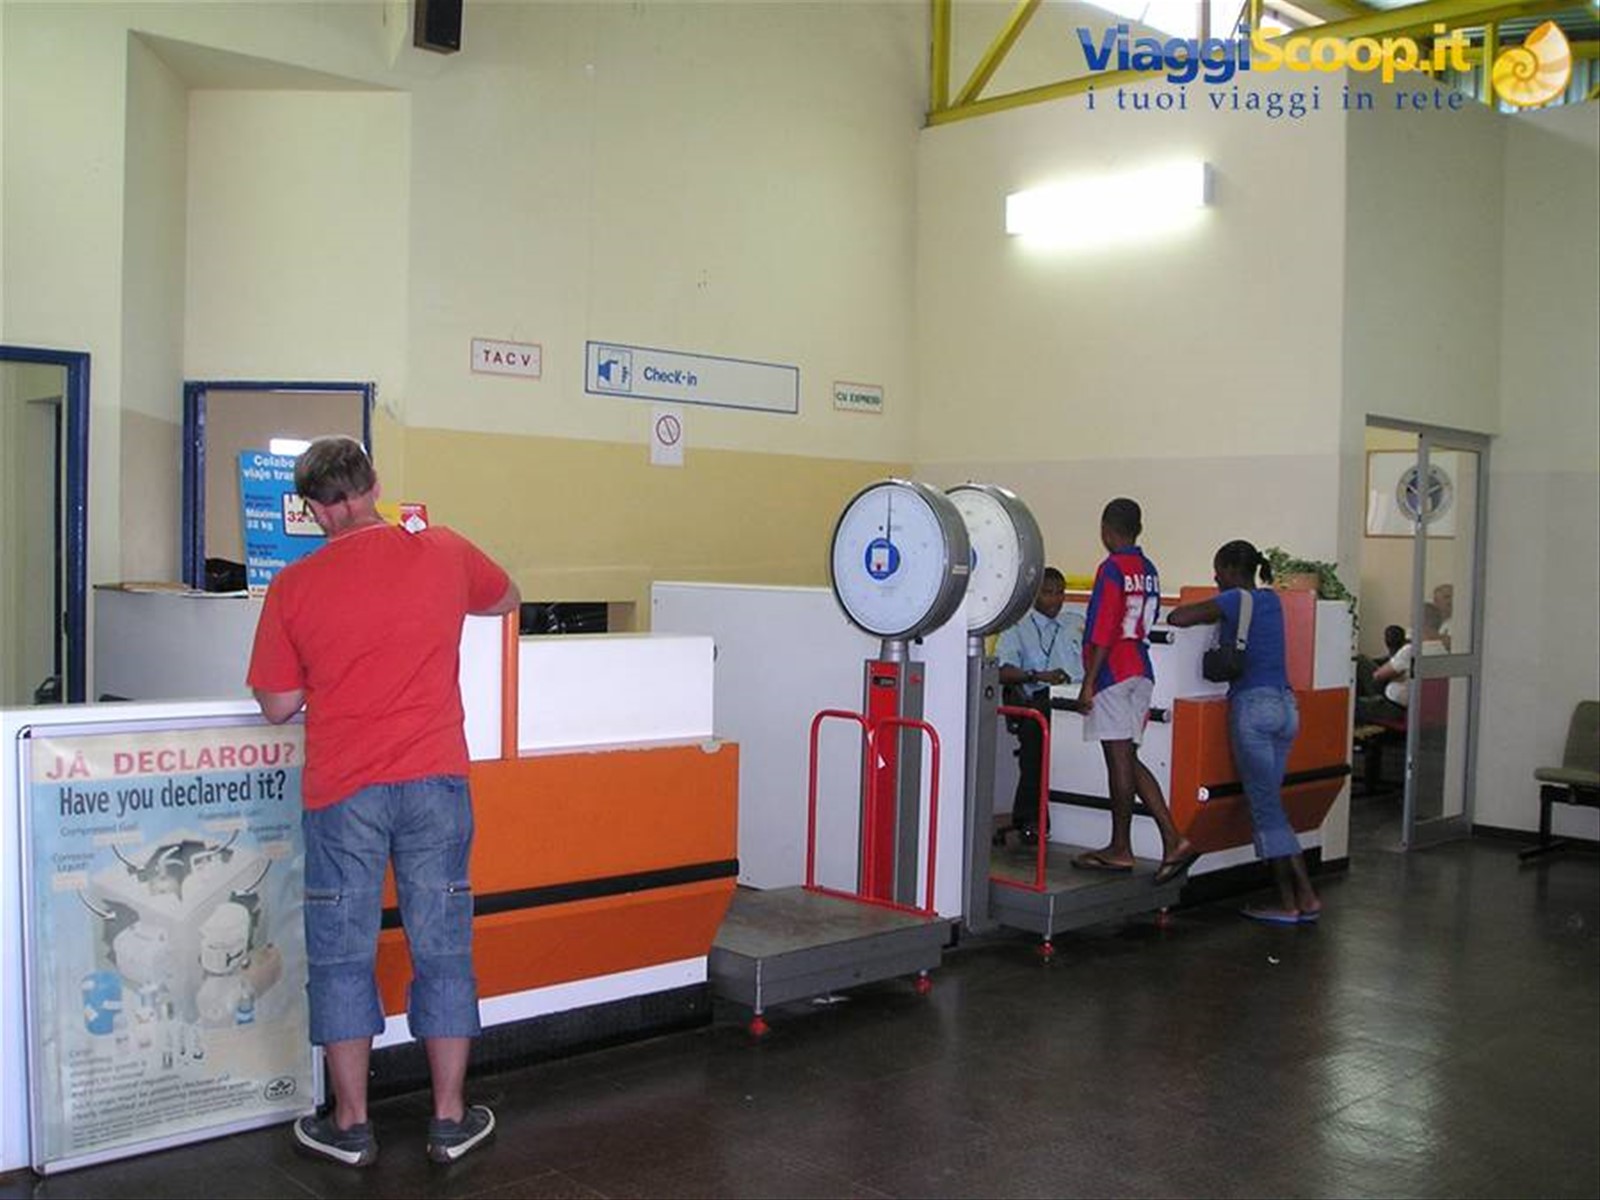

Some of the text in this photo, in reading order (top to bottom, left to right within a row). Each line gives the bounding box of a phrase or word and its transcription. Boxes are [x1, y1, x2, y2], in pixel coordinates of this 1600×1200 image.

[113, 742, 297, 775] DECLAROU?
[59, 769, 287, 818] Have you declared it?
